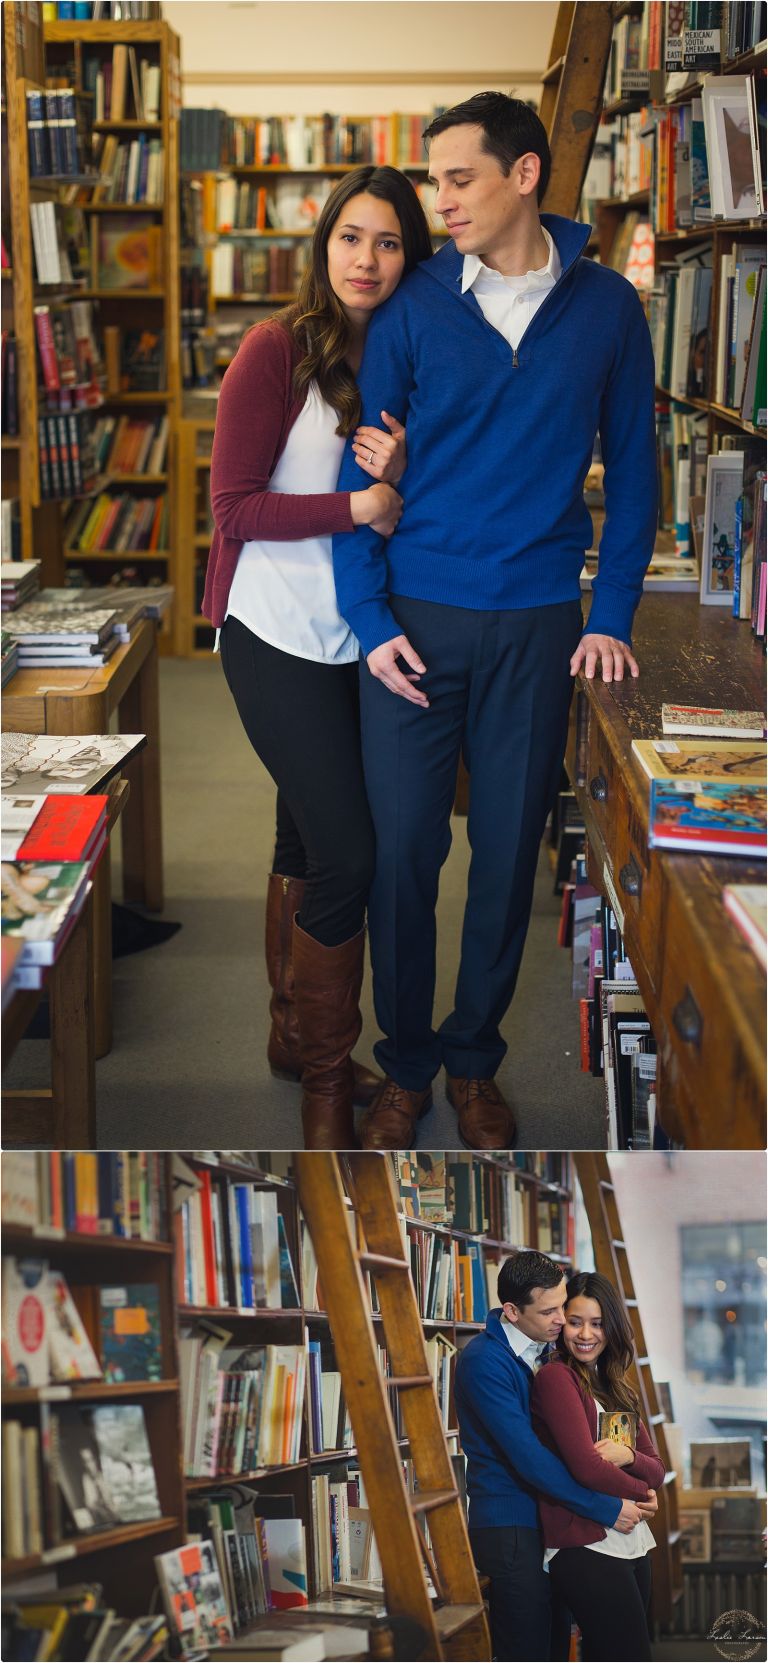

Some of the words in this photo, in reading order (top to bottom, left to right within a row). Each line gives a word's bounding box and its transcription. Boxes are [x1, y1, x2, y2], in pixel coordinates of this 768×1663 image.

[685, 31, 713, 39] MEXICAN/
[685, 45, 714, 53] AMERICAN
[685, 55, 696, 63] ART
